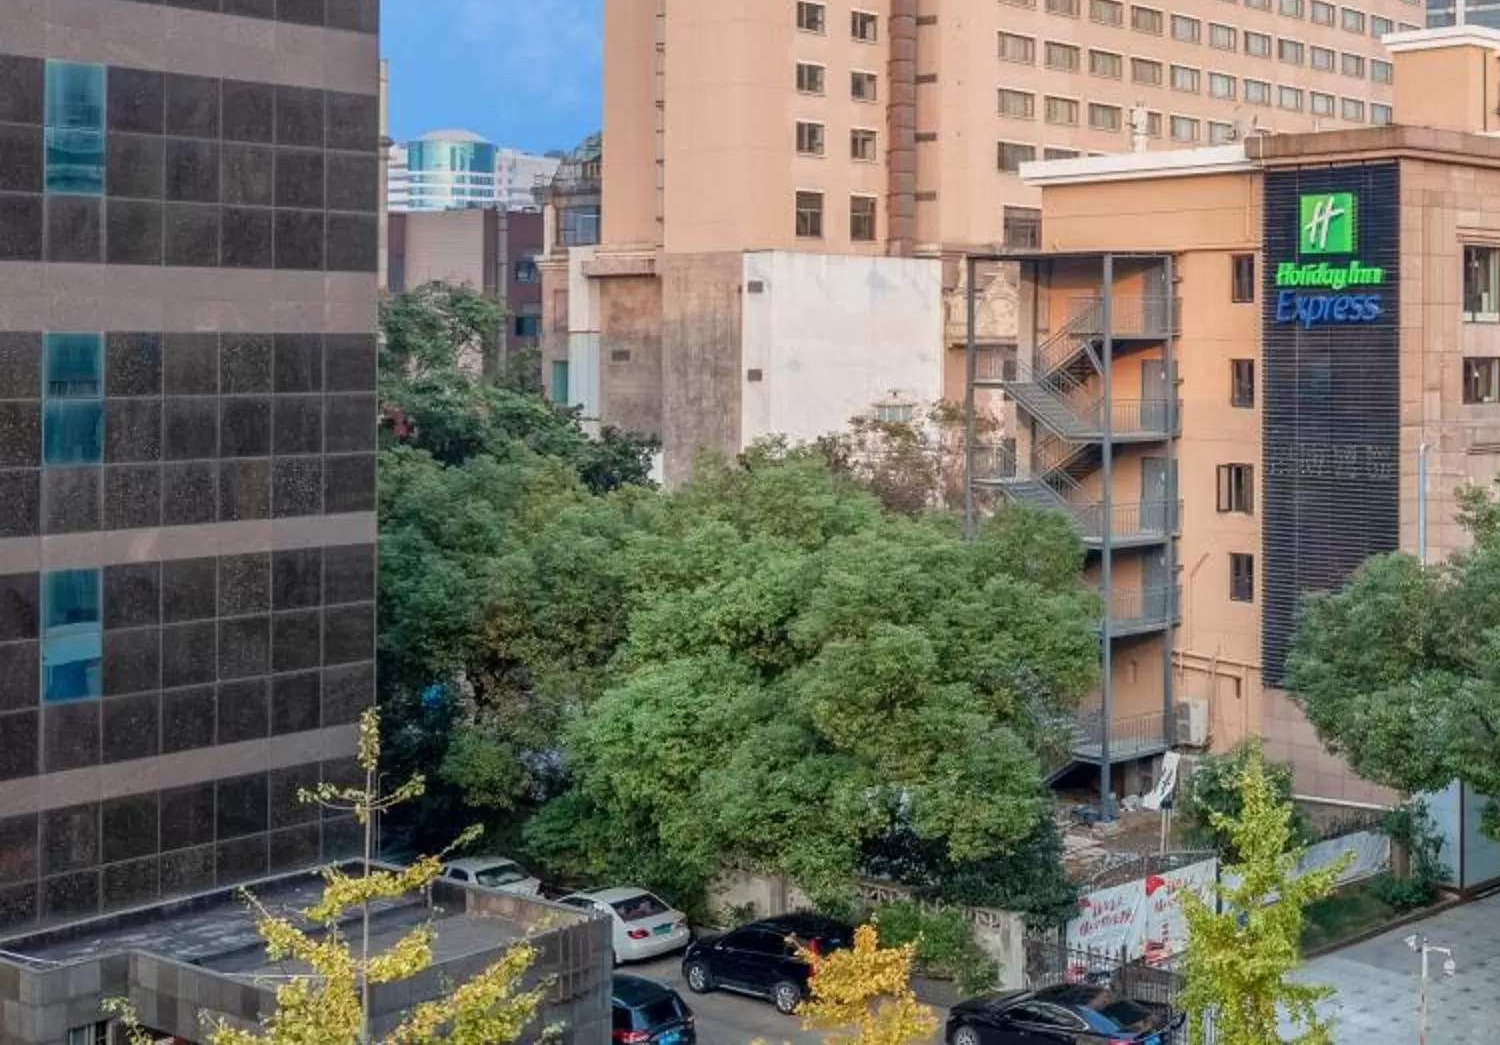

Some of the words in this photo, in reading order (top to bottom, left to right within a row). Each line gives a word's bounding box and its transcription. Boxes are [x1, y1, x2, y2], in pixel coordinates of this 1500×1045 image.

[1275, 262, 1347, 290] Holiday
[1349, 260, 1384, 285] Inn
[1275, 290, 1384, 329] Express
